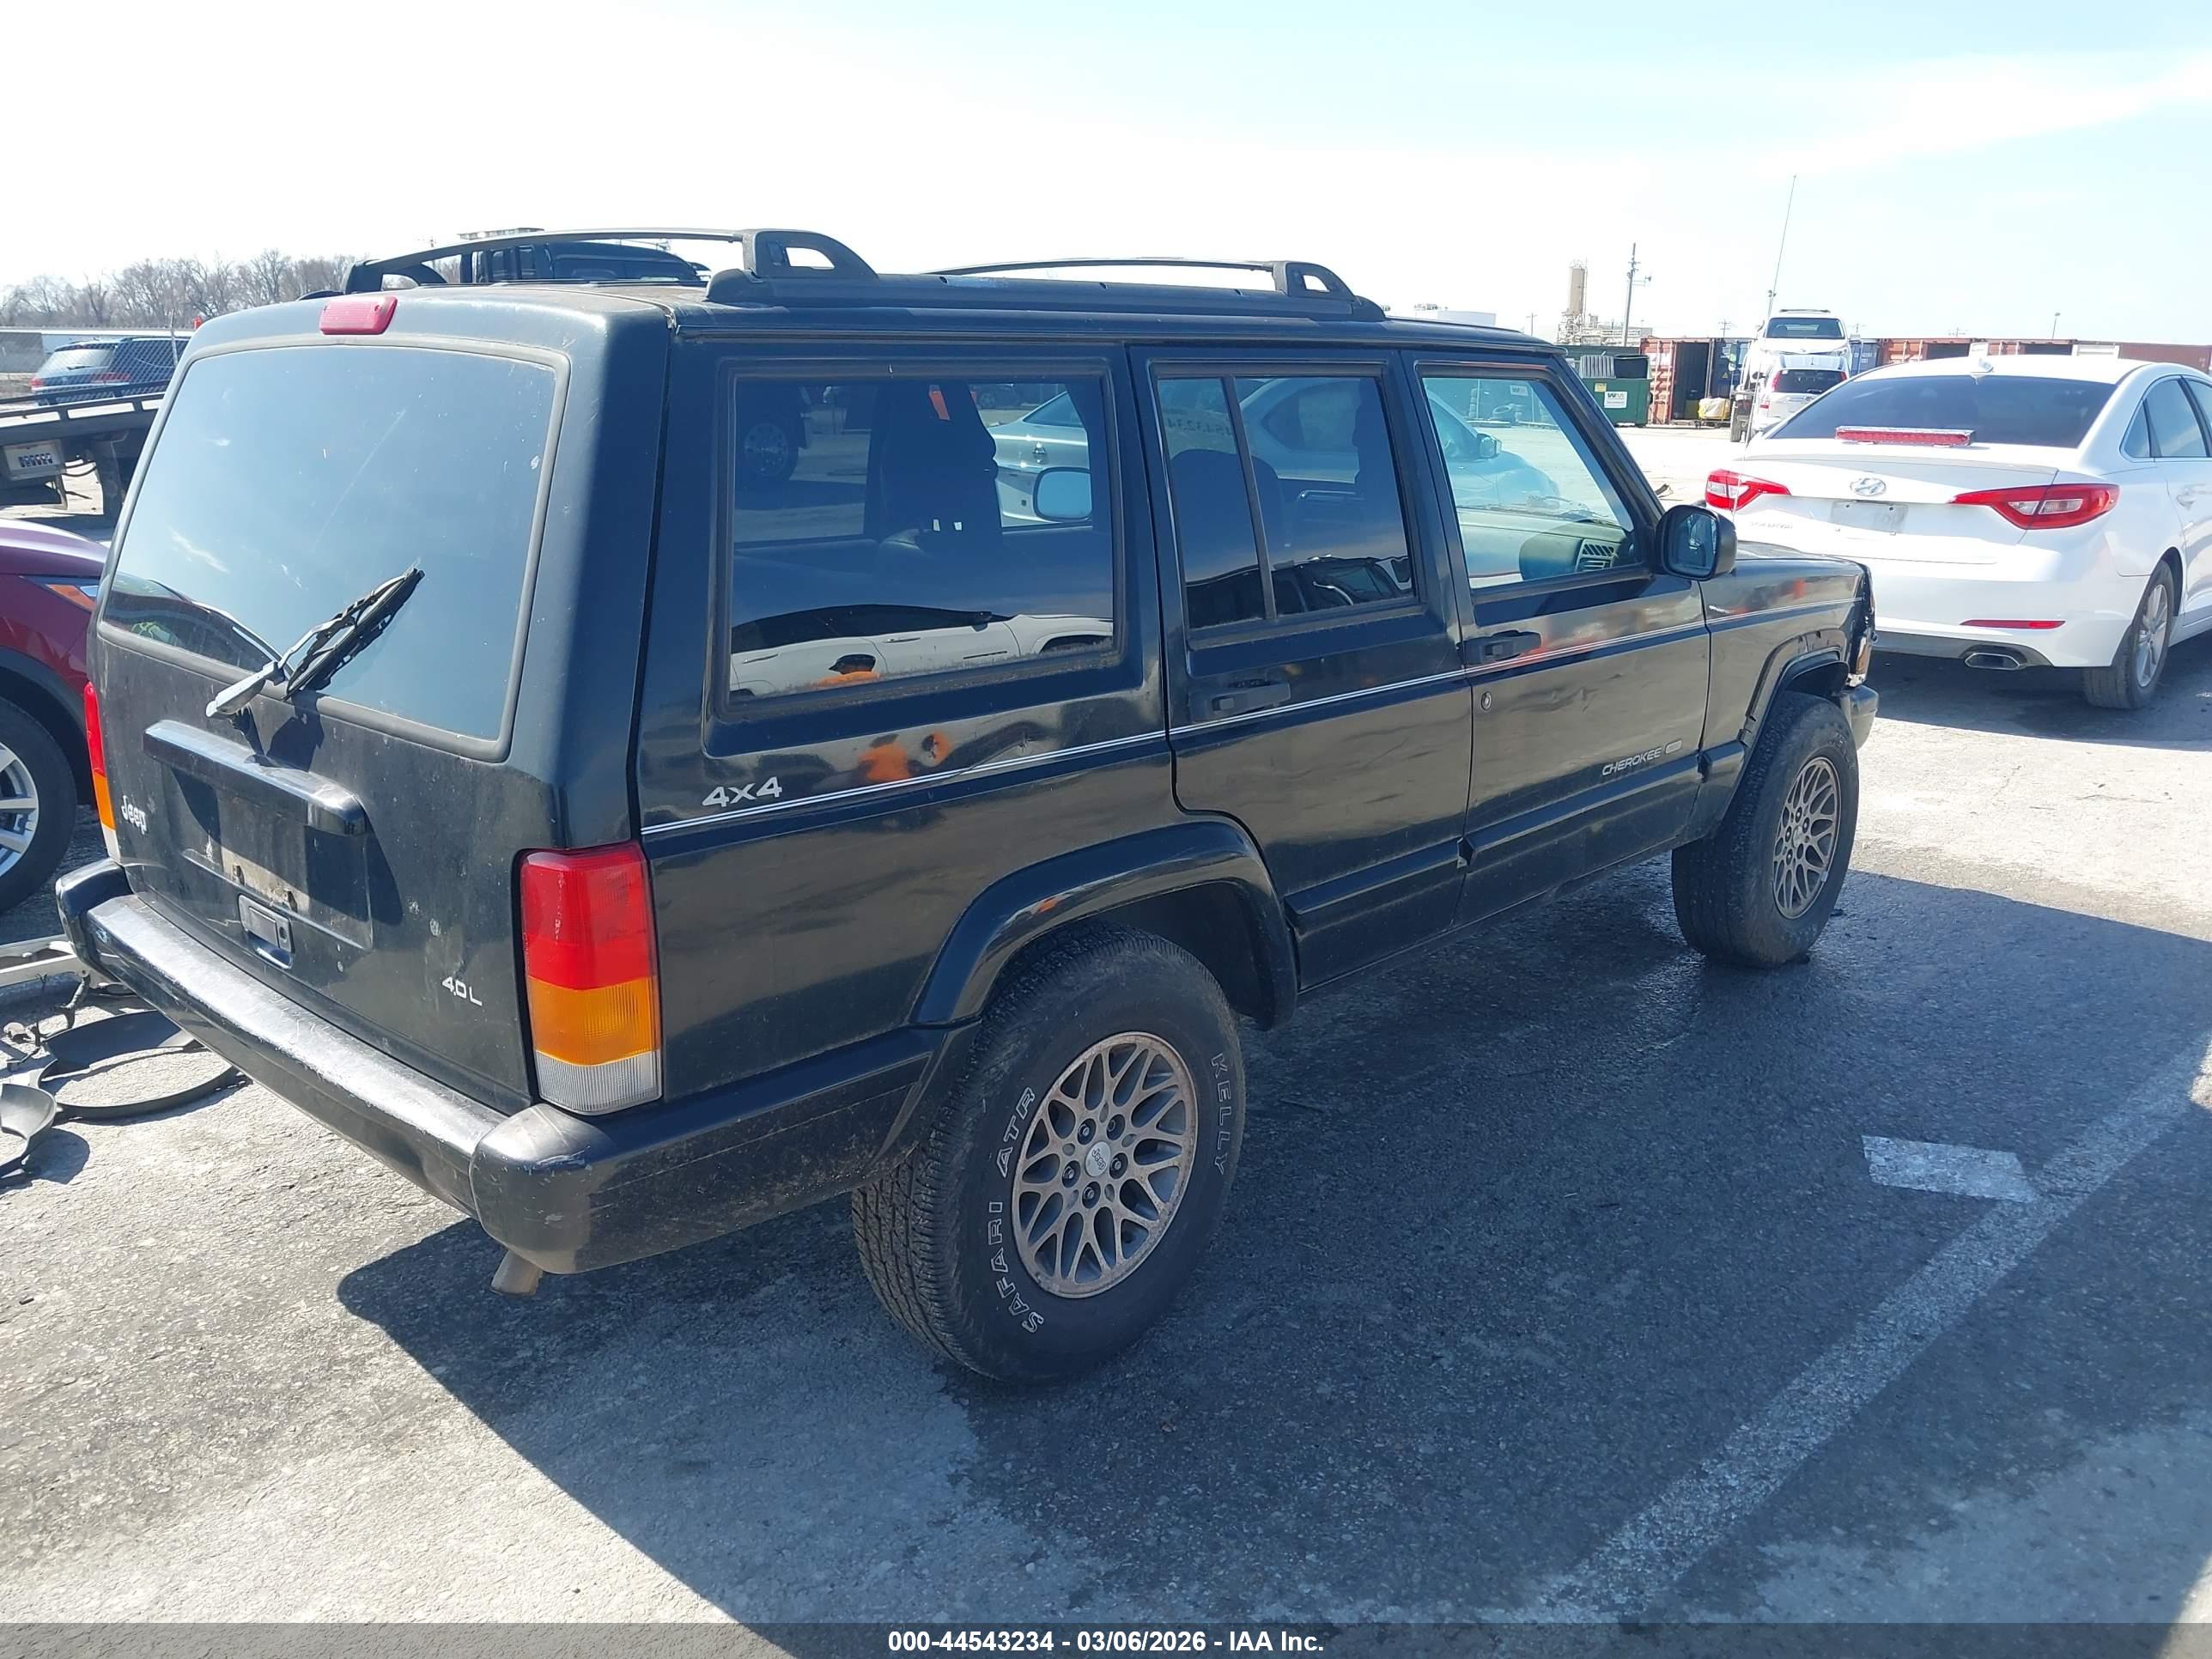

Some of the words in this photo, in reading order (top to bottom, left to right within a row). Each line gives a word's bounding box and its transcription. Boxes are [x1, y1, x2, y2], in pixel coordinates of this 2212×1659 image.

[1601, 747, 1662, 776] CHEROKEE
[121, 795, 147, 835] Jeep
[996, 1086, 1036, 1177] ATR
[1211, 1053, 1232, 1176] KELLY
[1091, 1147, 1107, 1170] Jeep
[988, 1201, 1044, 1333] SAFARI
